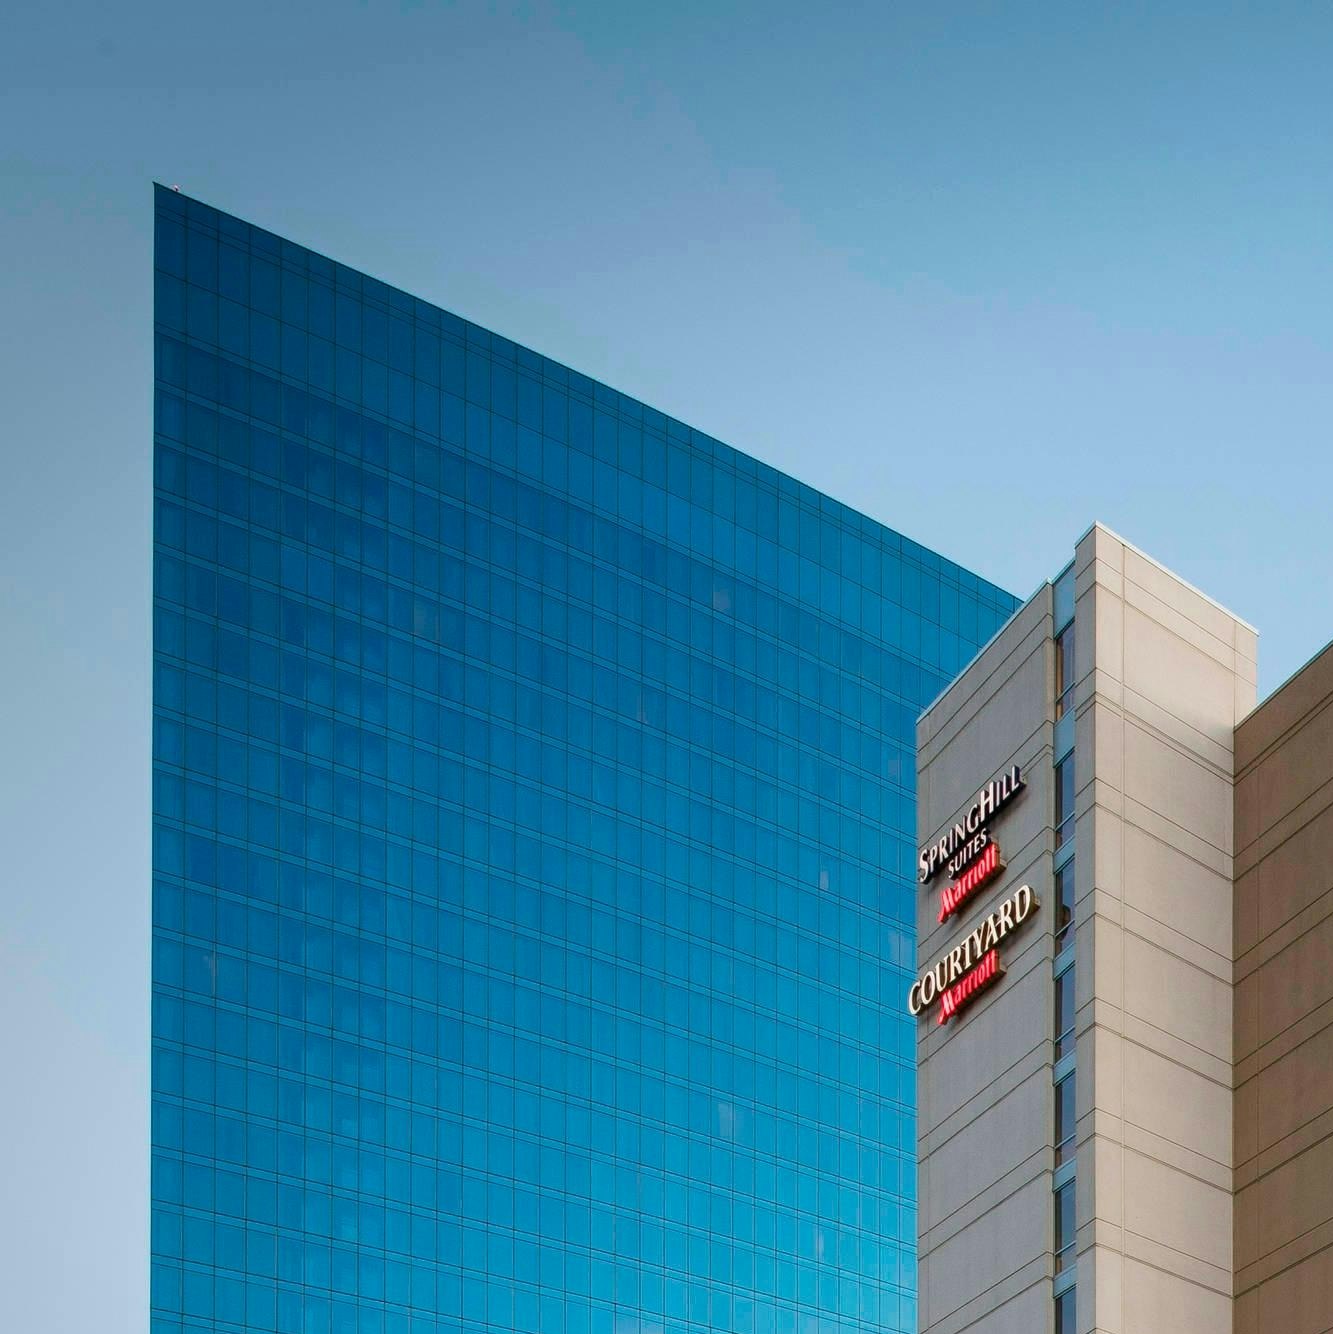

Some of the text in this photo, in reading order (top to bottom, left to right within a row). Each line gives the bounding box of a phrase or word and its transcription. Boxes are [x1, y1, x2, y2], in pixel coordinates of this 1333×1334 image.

[937, 842, 998, 923] Marriott
[948, 827, 989, 879] SUITES
[908, 884, 1032, 1015] COURTYARD
[937, 947, 998, 1025] Marriott
